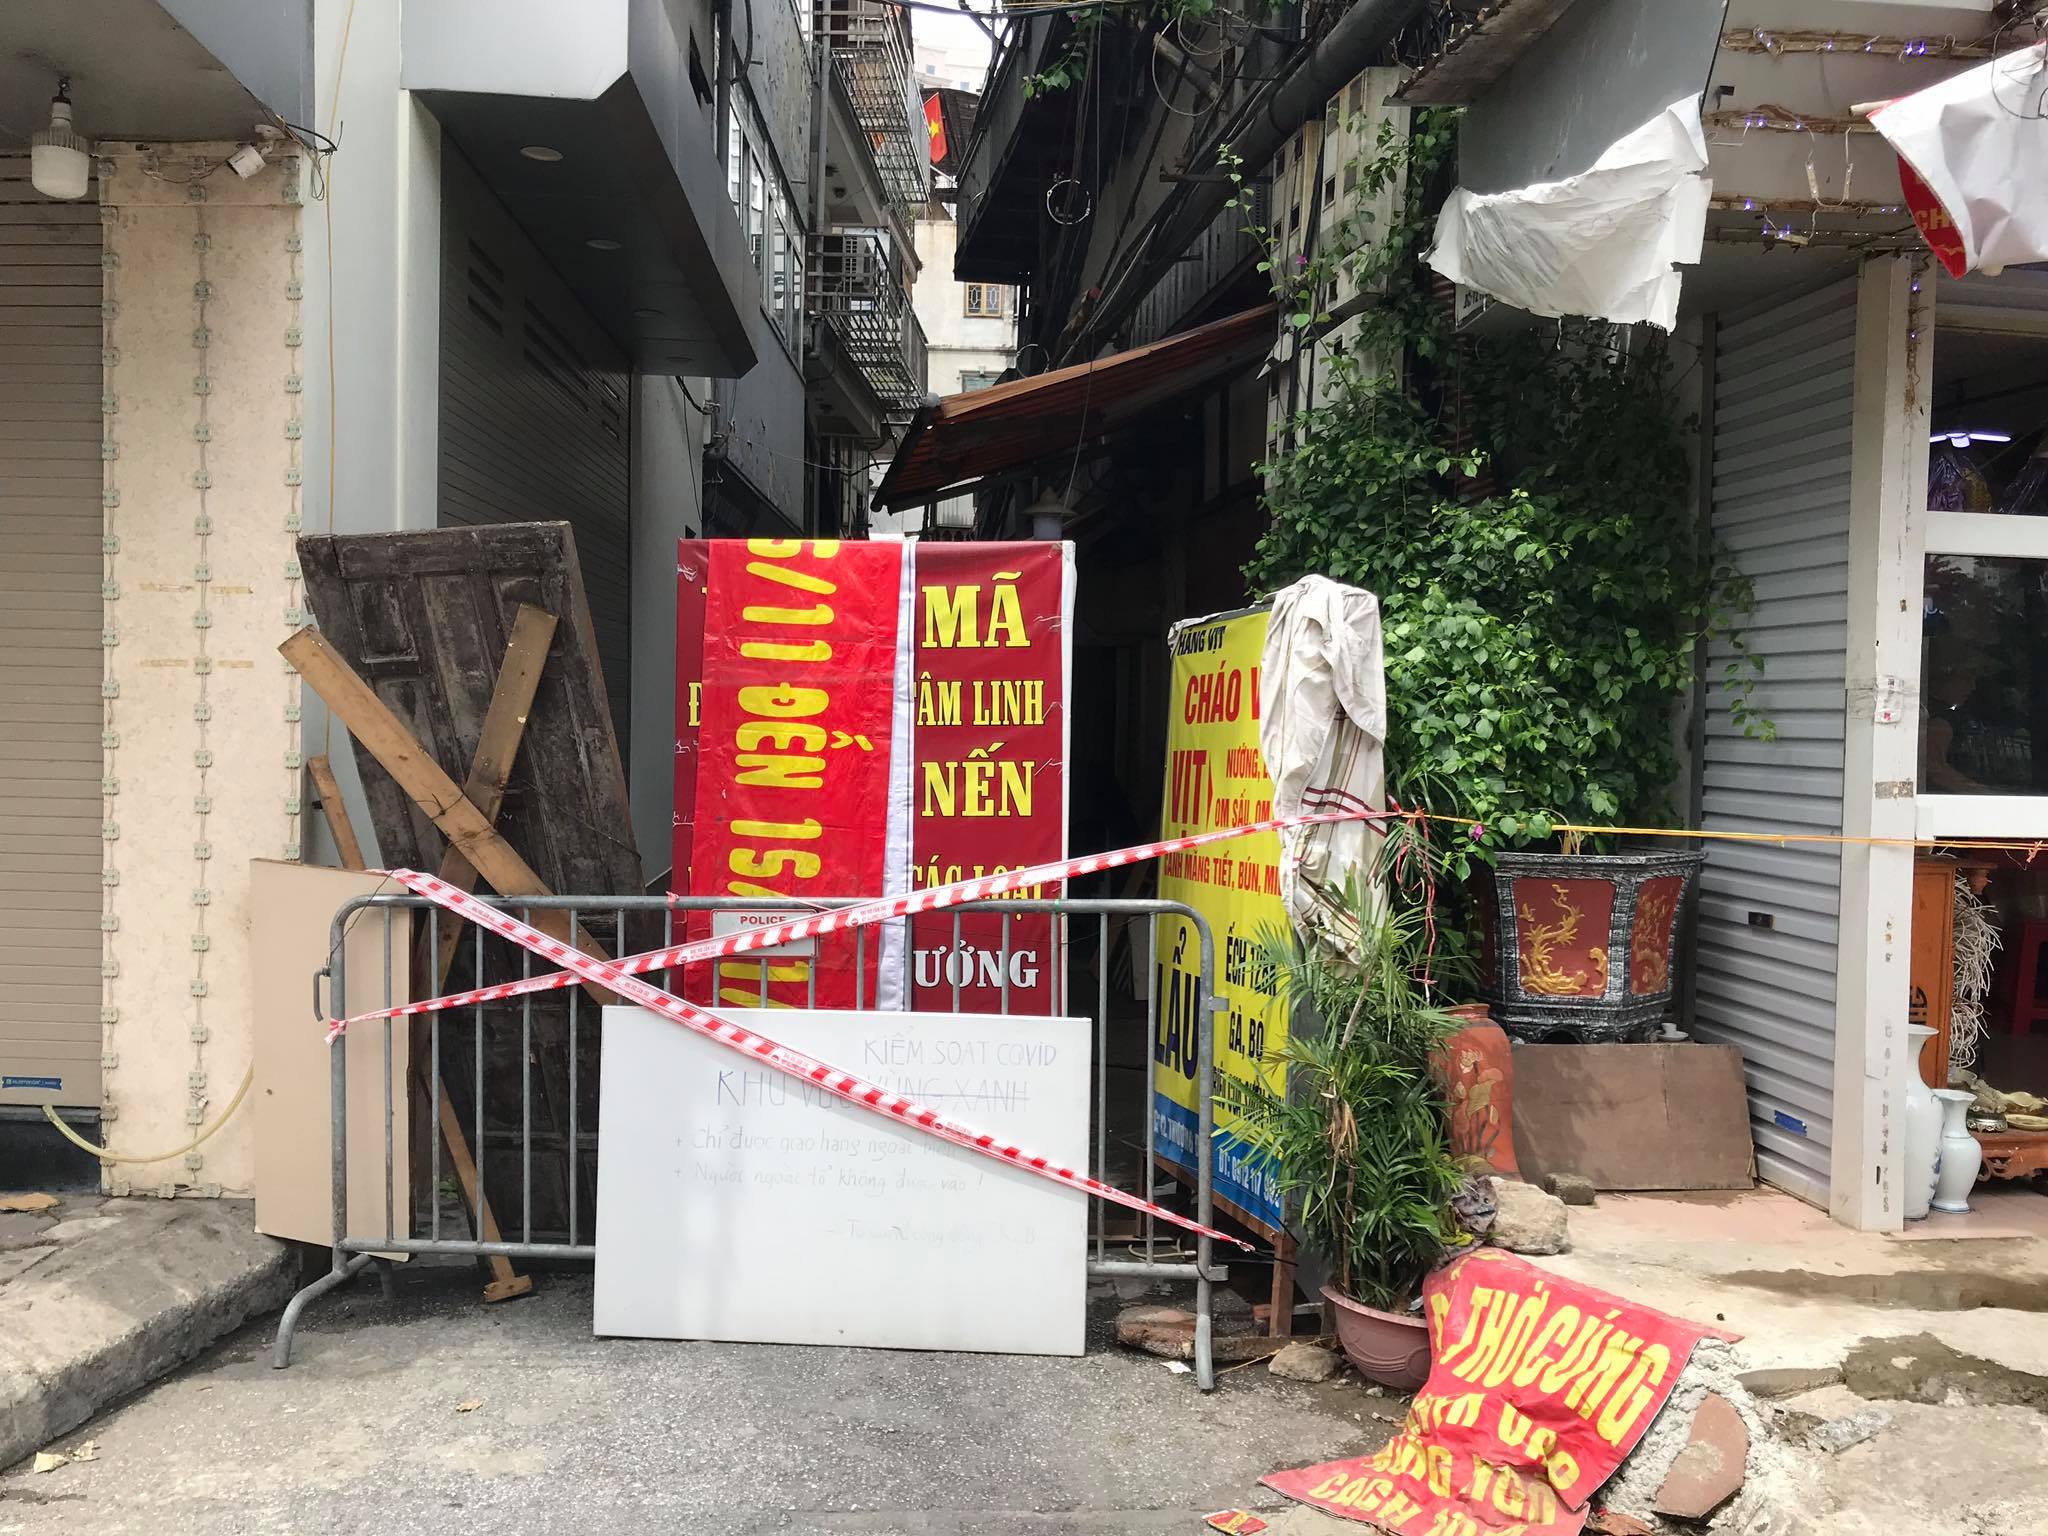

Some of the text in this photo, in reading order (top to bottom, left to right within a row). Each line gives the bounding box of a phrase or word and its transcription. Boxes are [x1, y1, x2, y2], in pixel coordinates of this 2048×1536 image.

[921, 571, 1031, 648] MÃ
[1208, 625, 1227, 654] VỊT
[914, 671, 962, 726] ÂM
[973, 680, 1044, 726] LINH
[1184, 660, 1242, 725] CHÁO
[734, 682, 874, 790] ĐẾN
[921, 742, 1035, 817] NẾN
[1171, 750, 1207, 838] VỊT
[1215, 798, 1230, 827] OM
[740, 915, 789, 925] POLICE
[1154, 926, 1201, 1080] LẨU
[718, 1070, 786, 1107] KHU
